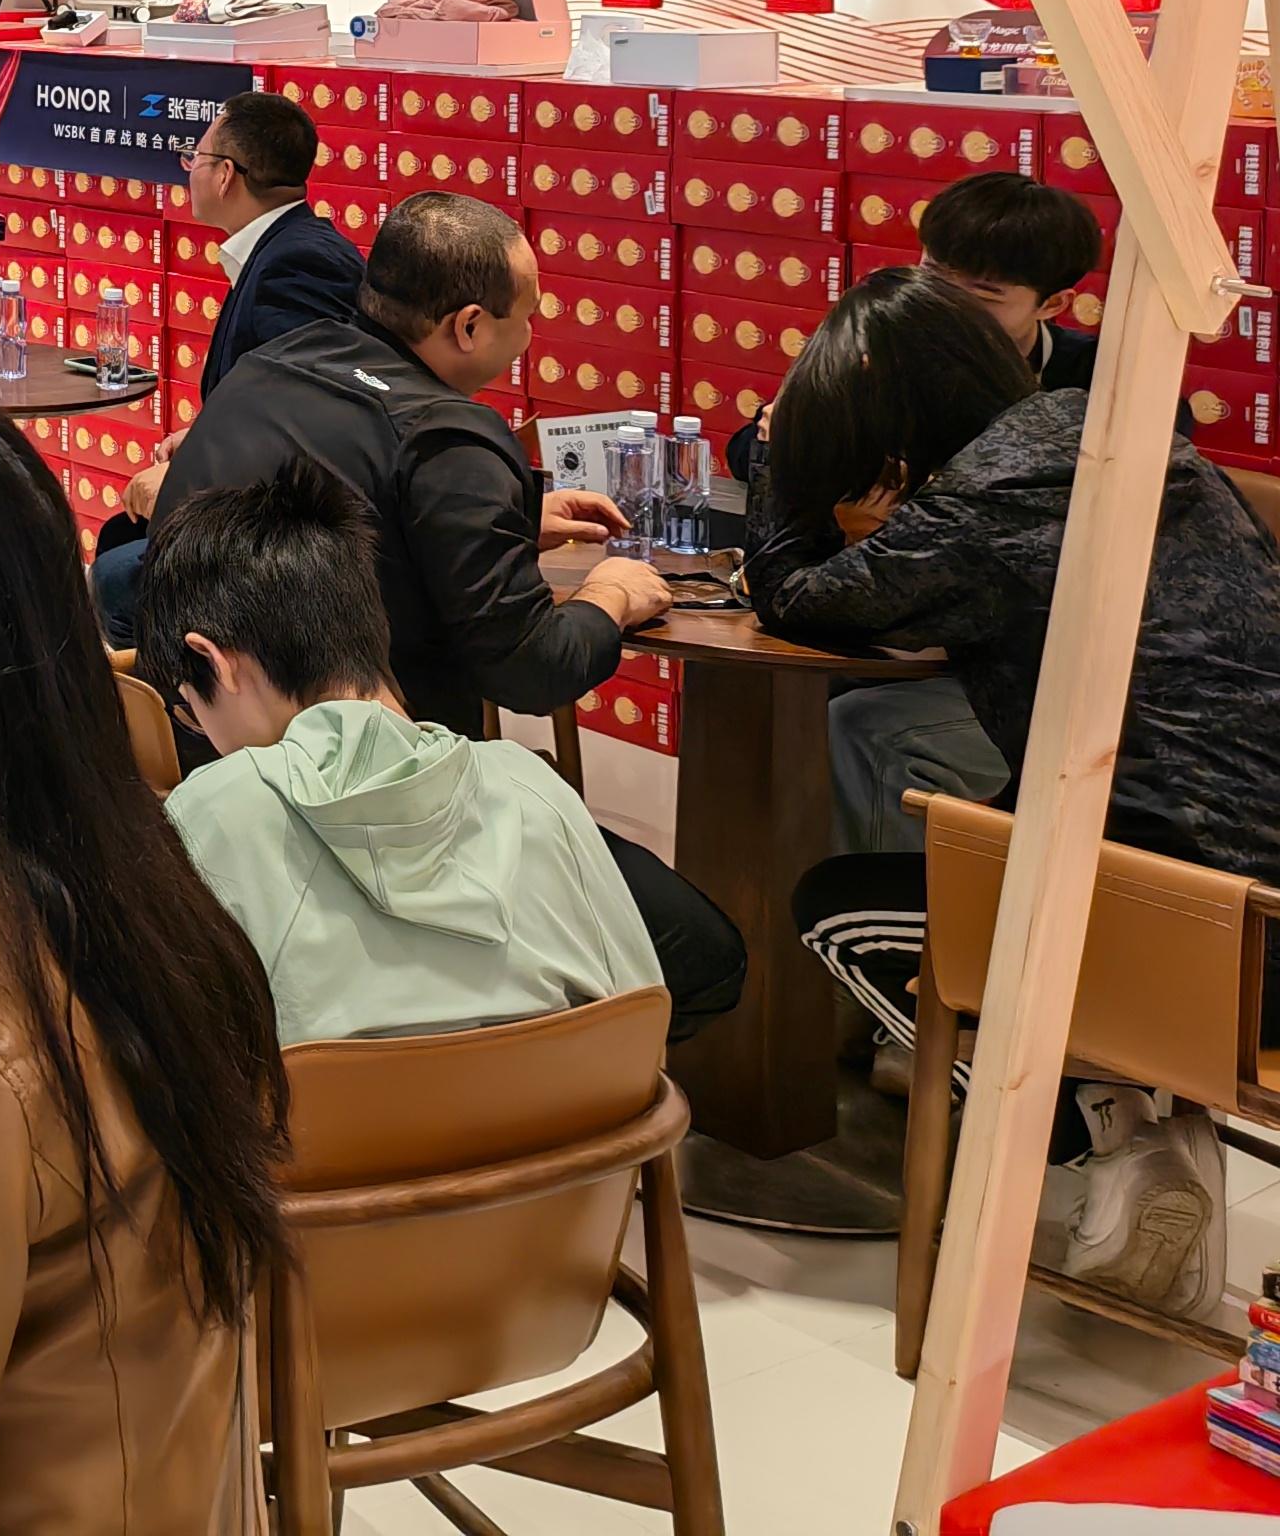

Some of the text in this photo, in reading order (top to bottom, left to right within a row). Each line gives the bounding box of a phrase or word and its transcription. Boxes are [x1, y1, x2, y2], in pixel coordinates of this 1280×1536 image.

[989, 26, 1021, 37] Magic
[36, 84, 111, 113] HONOR
[53, 124, 86, 140] WSBK
